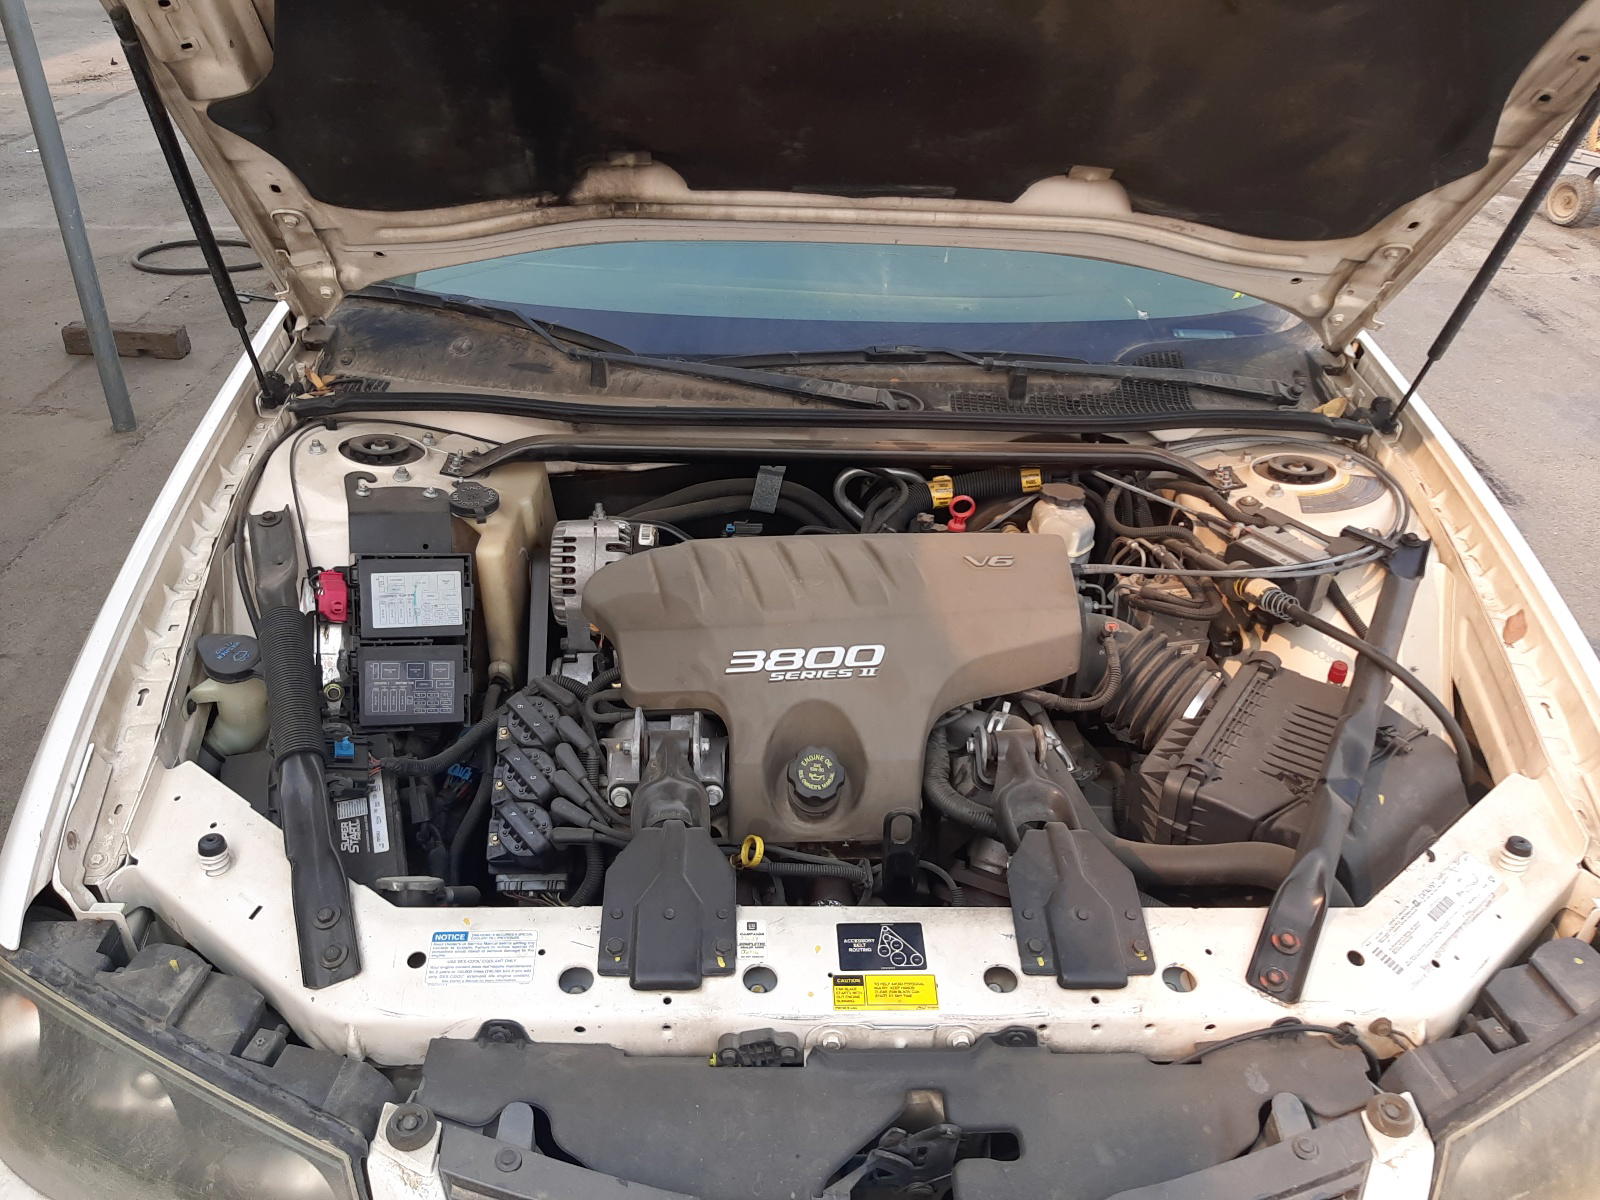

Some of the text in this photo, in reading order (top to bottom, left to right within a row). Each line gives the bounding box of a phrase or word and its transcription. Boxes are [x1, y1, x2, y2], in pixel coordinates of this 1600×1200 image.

[962, 555, 1015, 568] V6
[725, 644, 886, 674] 3800
[768, 667, 879, 682] SERIES II
[801, 754, 825, 767] ENGINE
[341, 822, 350, 851] SUPER
[348, 820, 360, 853] START
[434, 933, 466, 941] NOTICE
